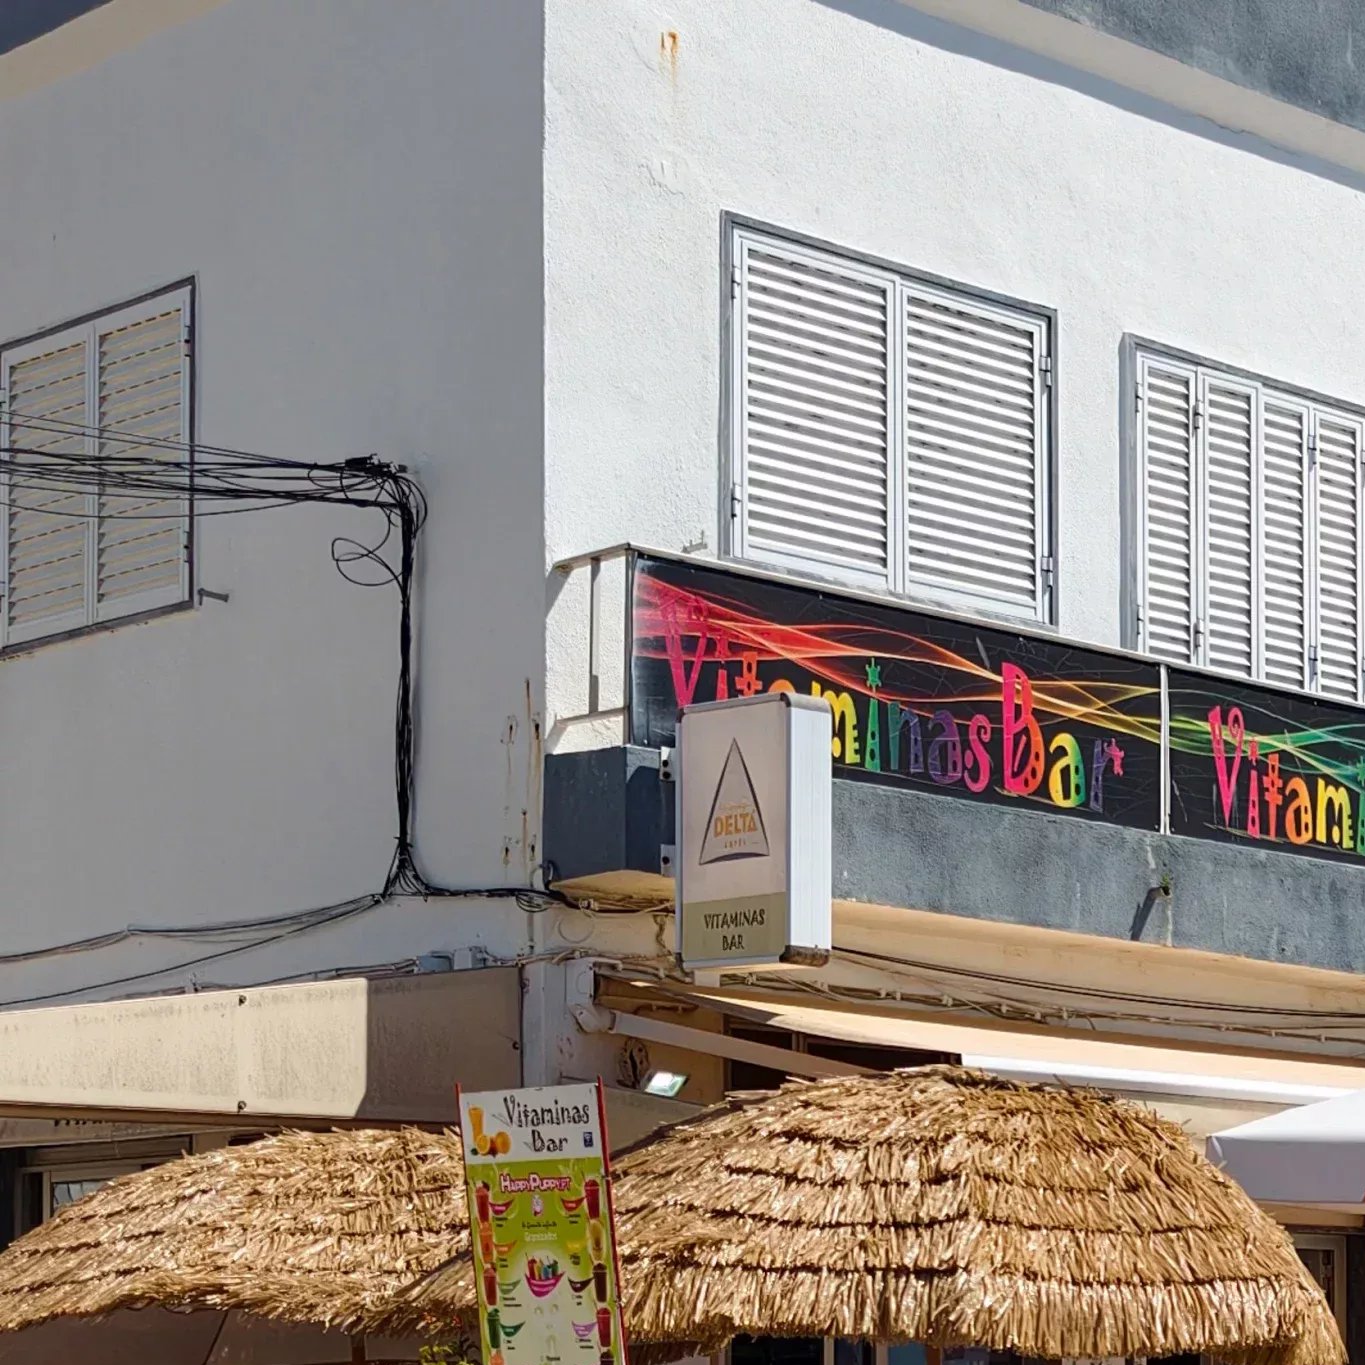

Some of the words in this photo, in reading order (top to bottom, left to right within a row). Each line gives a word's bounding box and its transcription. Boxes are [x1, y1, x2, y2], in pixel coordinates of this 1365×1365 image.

[658, 594, 991, 793] Vitminas
[1002, 661, 1125, 812] Bar
[714, 810, 758, 838] DELTA
[703, 908, 766, 930] VITAMINAS
[722, 935, 745, 951] BAR
[503, 1094, 590, 1128] Vitaminas
[531, 1129, 568, 1153] Bar
